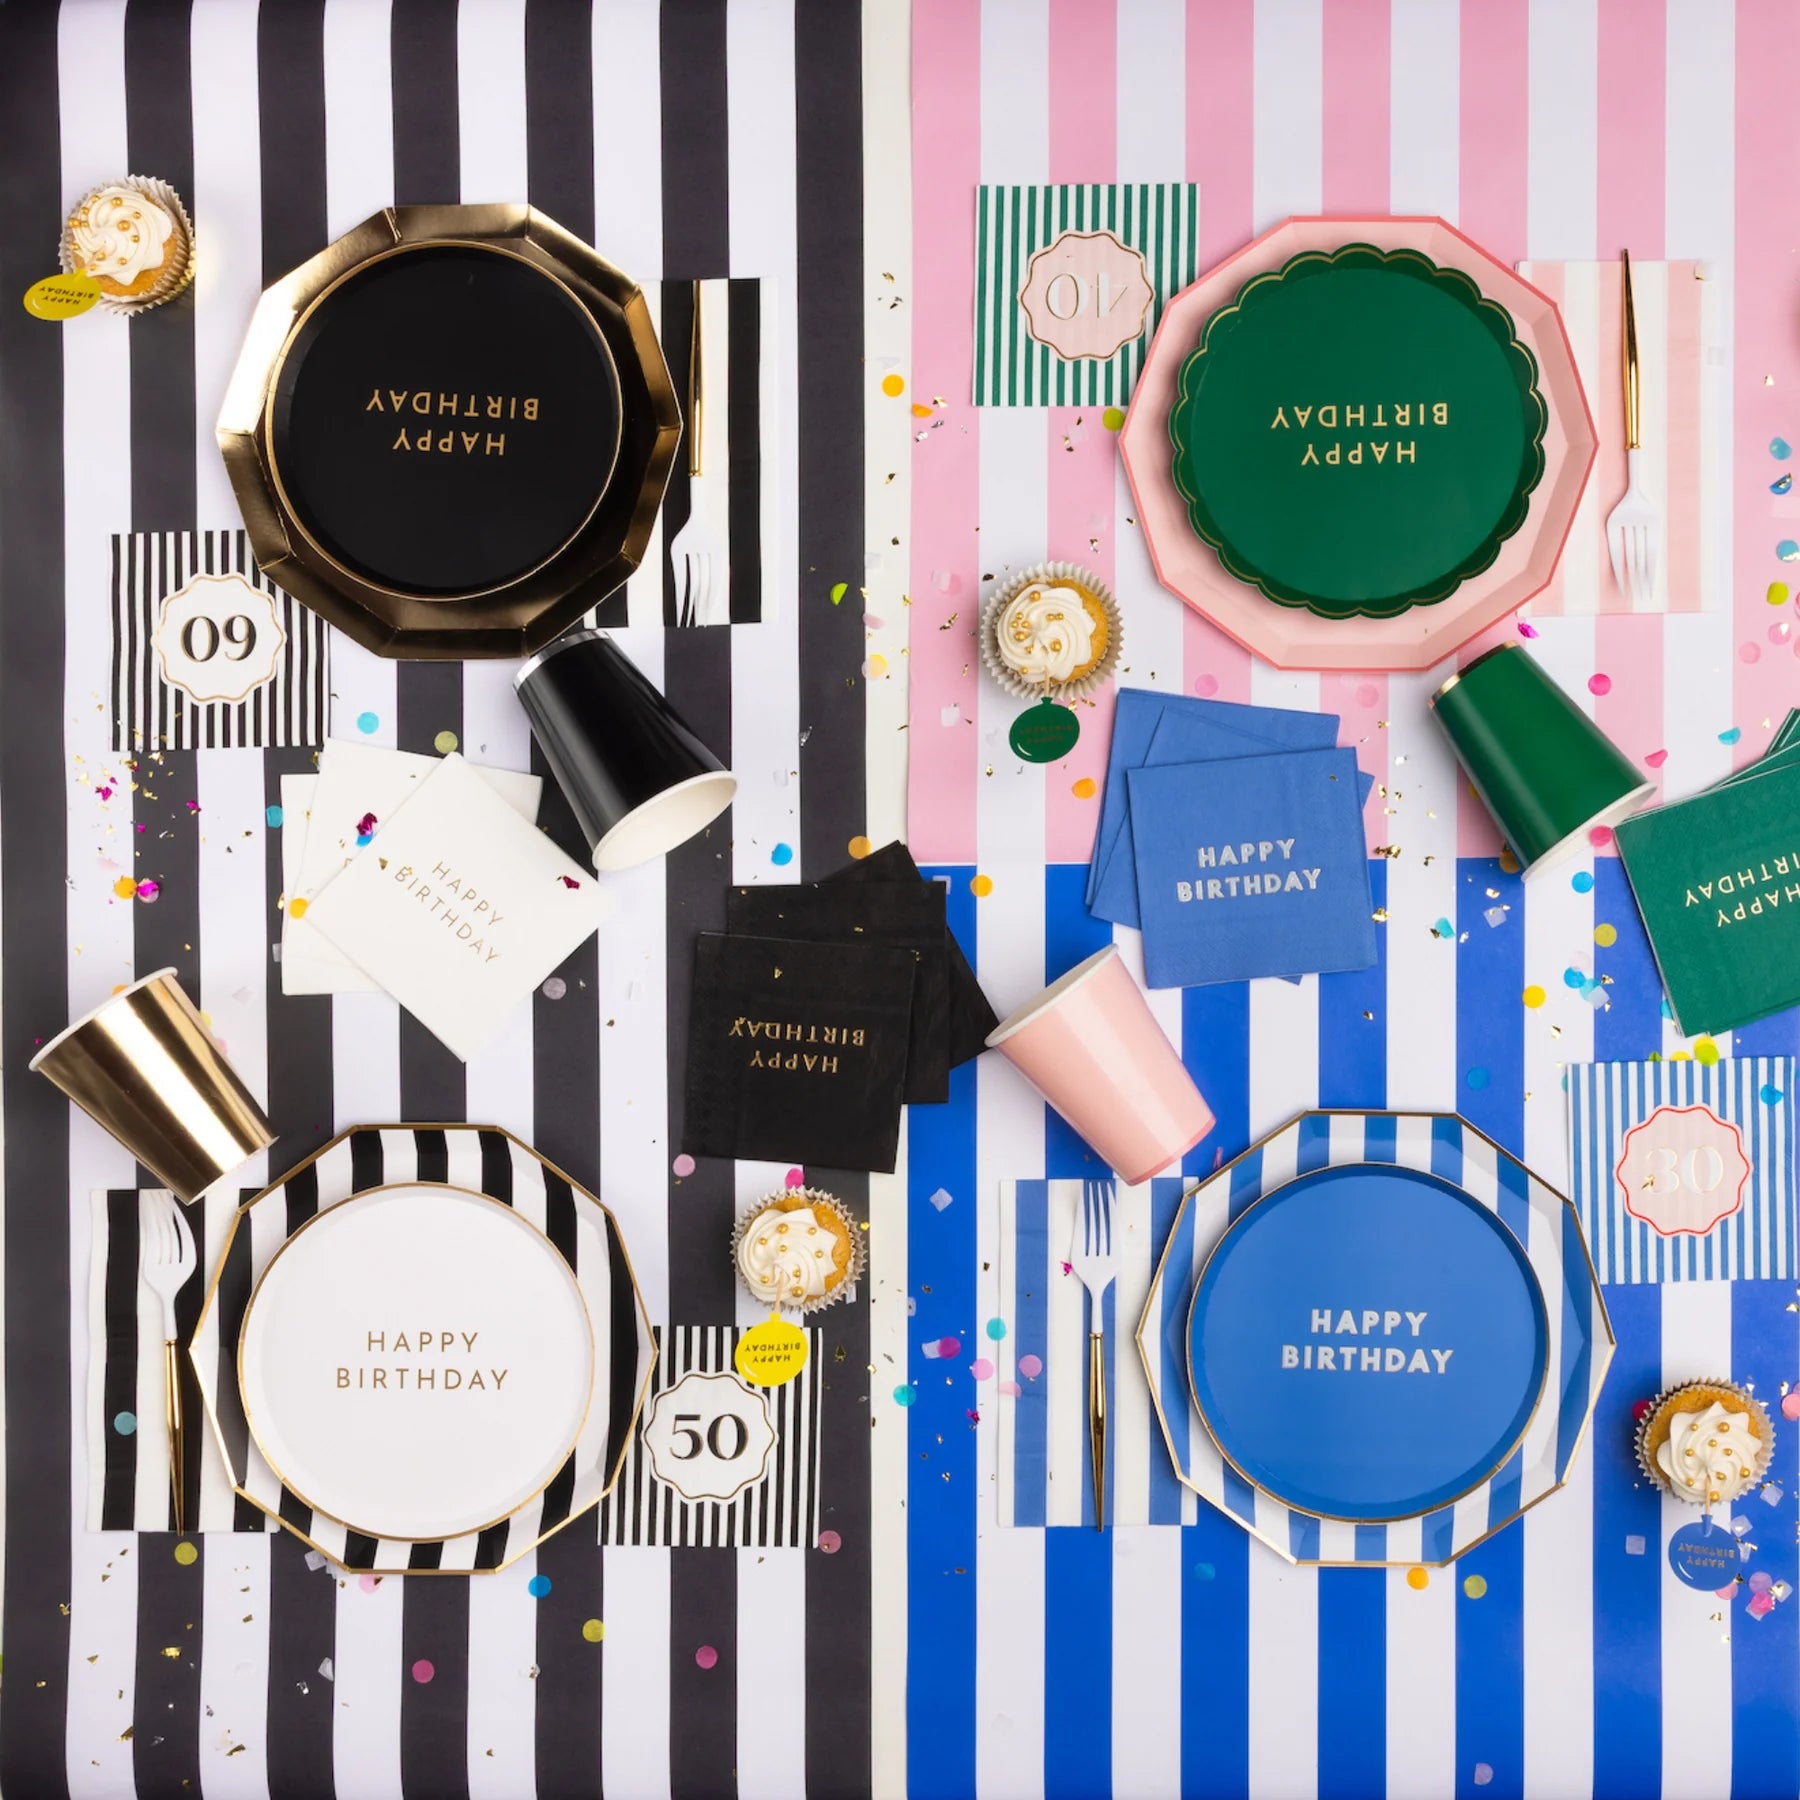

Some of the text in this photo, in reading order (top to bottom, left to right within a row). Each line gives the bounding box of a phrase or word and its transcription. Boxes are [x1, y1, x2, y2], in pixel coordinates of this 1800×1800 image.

[1045, 271, 1129, 321] 40
[365, 388, 540, 421] BIRTHDAY
[1270, 402, 1449, 429] BIRTHDAY
[392, 427, 506, 456] HAPPY
[1300, 441, 1416, 466] HAPPY
[1197, 838, 1296, 869] HAPPY
[431, 861, 503, 926] HAPPY
[1176, 868, 1321, 903] BIRTHDAY
[1685, 852, 1800, 908] IRTHDAY
[394, 866, 501, 963] BIRTHDAY
[1717, 882, 1800, 928] HAPPY
[728, 1020, 866, 1046] BIRTHDAY
[750, 1050, 839, 1074] HAPPY
[1645, 1146, 1724, 1195] 30
[1310, 1308, 1429, 1337] HAPPY
[367, 1330, 479, 1353] HAPPY
[744, 1342, 801, 1353] BIRTHDAY
[752, 1354, 791, 1364] HAPPY
[1280, 1344, 1454, 1375] BIRTHDAY
[336, 1367, 509, 1391] BIRTHDAY
[668, 1412, 749, 1461] 50
